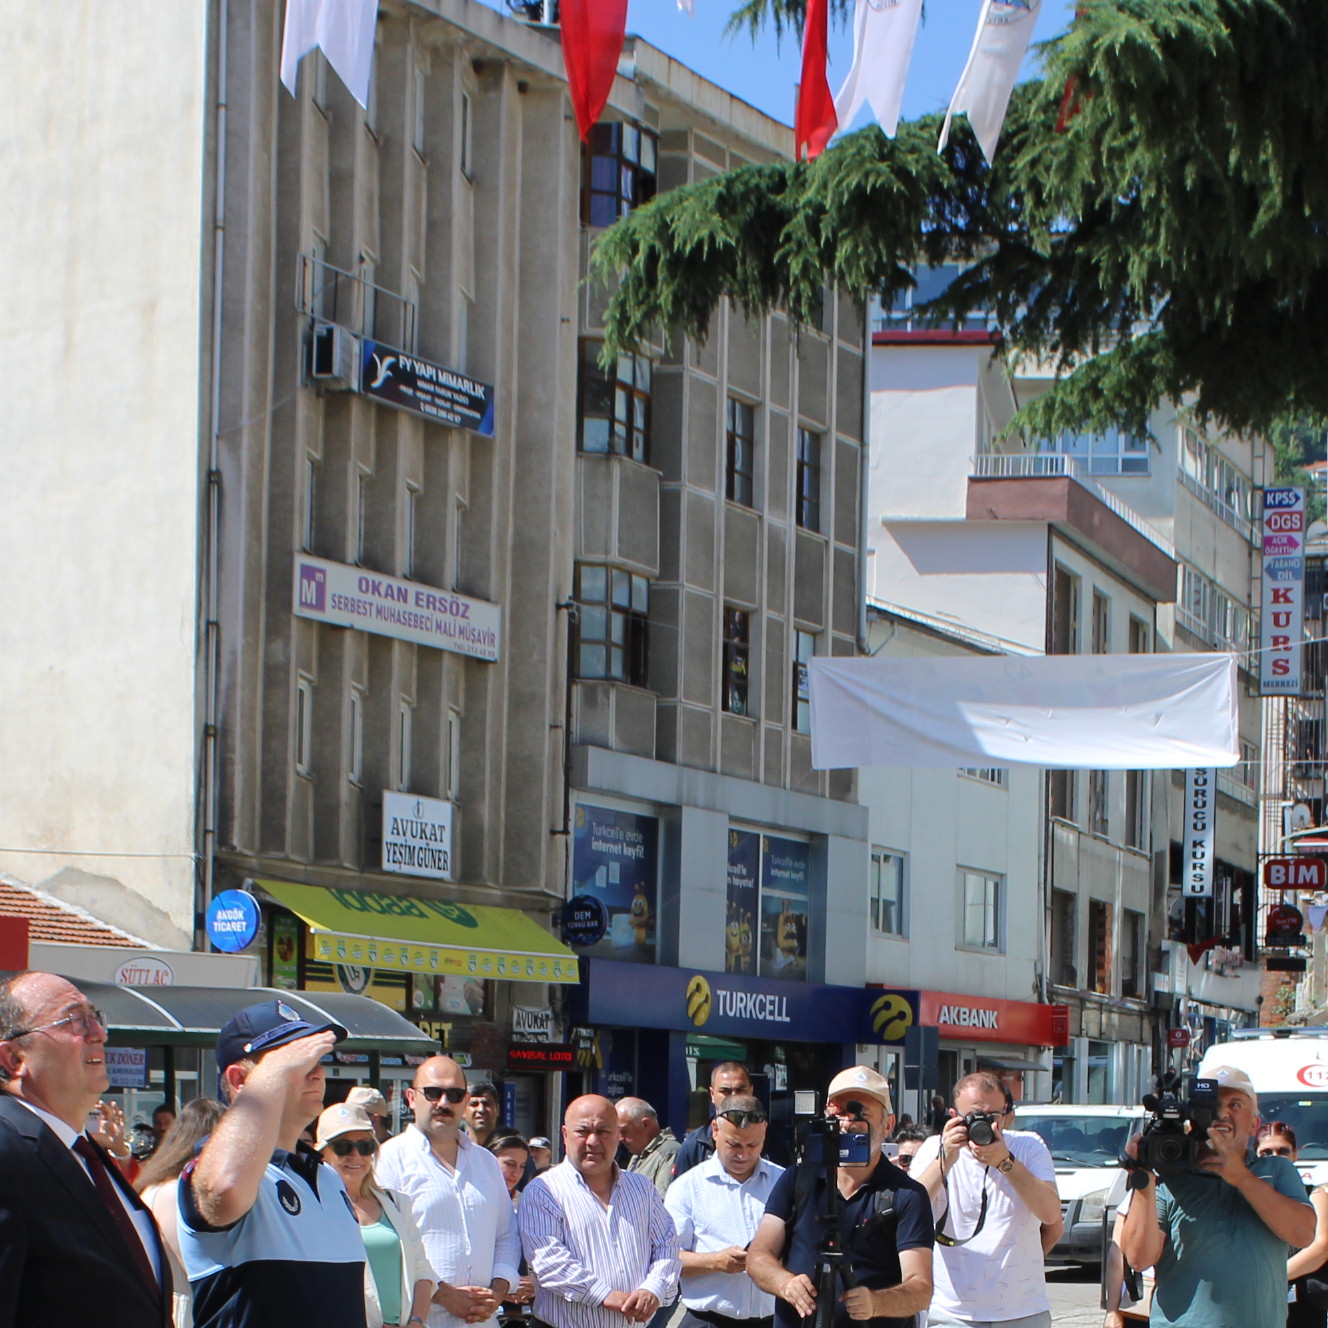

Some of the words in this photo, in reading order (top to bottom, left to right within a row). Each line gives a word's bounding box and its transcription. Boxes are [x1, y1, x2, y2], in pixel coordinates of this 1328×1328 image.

[399, 354, 414, 372] FY
[413, 360, 436, 382] YAPI
[1266, 491, 1297, 506] KPSS
[1272, 512, 1301, 530] DGS
[1277, 570, 1295, 581] DİL
[358, 575, 409, 604] OKAN
[414, 589, 471, 620] ERSÖZ
[331, 594, 373, 623] SERBEST
[375, 603, 433, 632] MUHASEBECİ
[435, 617, 457, 638] MALİ
[458, 624, 496, 649] MÜŞAVİR
[1270, 588, 1294, 676] KURS
[390, 816, 446, 843] AVUKAT
[385, 838, 416, 871] YEŞİM
[416, 842, 449, 872] GÜNER
[591, 837, 621, 853] internet
[1190, 840, 1205, 894] KURSU
[1272, 860, 1319, 885] BİM
[213, 920, 247, 933] TİCARET
[216, 907, 244, 922] AKGÖK
[574, 910, 592, 921] DEM
[716, 989, 791, 1023] TURKCELL
[938, 1004, 1000, 1030] AKBANK
[515, 1008, 551, 1031] AVUKAT
[549, 1051, 572, 1062] LOTO
